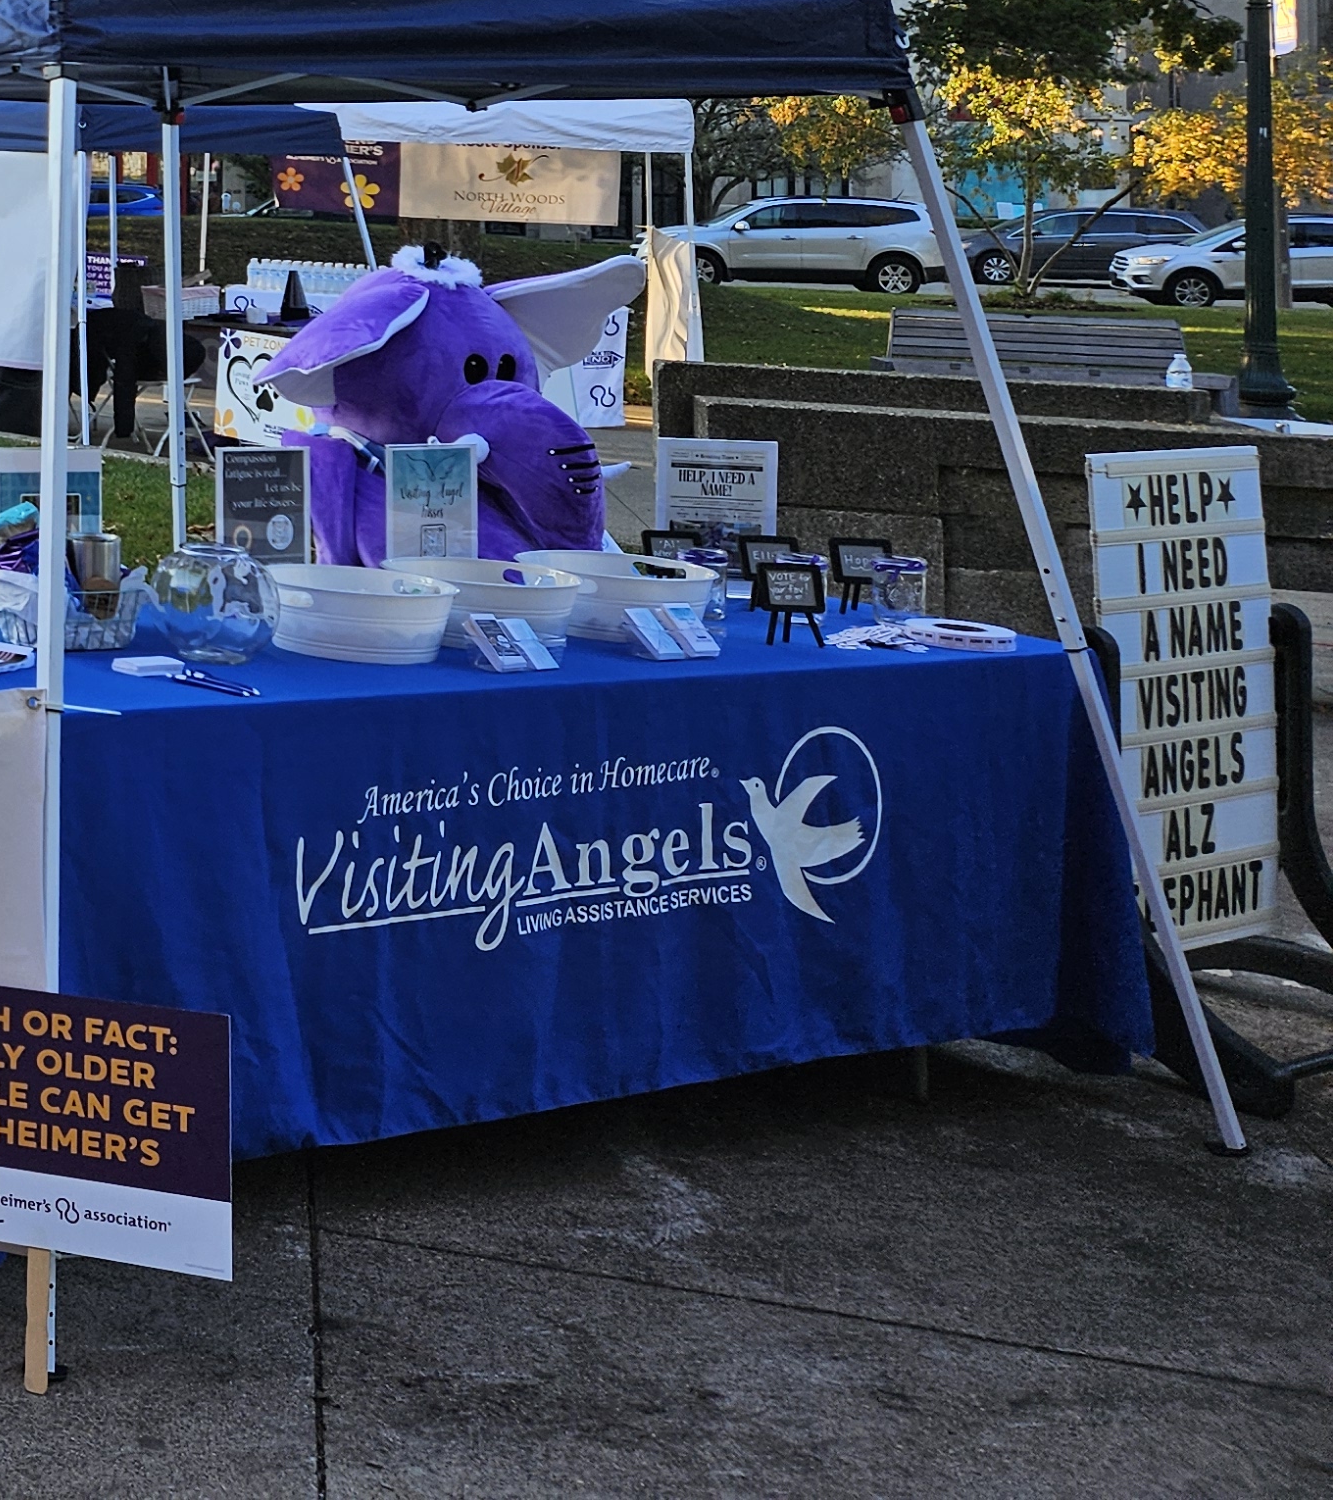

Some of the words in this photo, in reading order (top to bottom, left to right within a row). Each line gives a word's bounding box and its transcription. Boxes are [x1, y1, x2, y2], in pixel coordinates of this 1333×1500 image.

[454, 191, 506, 201] NORTH
[510, 192, 565, 204] WOODS
[481, 200, 537, 217] Village
[243, 336, 260, 347] PET
[225, 454, 276, 466] Compassion
[225, 469, 254, 481] fatigue
[679, 470, 709, 484] HELP,
[712, 471, 715, 482] I
[719, 472, 745, 485] NEED
[748, 473, 755, 485] A
[233, 501, 252, 511] your
[254, 498, 267, 507] life
[265, 483, 278, 492] Let
[292, 482, 301, 491] be
[701, 482, 732, 496] NAME!
[1148, 472, 1213, 526] HELP
[769, 573, 795, 581] VOTE
[1138, 543, 1146, 594] I
[1162, 537, 1228, 593] NEED
[1144, 610, 1160, 662] A
[1170, 600, 1244, 658] NAME
[1138, 665, 1247, 730] VISITING
[1144, 732, 1245, 798] ANGELS
[356, 771, 480, 824] America's
[486, 770, 563, 808] Choice
[569, 763, 595, 795] in
[1165, 803, 1216, 862] ALZ
[295, 820, 526, 951] Visiting
[516, 911, 563, 936] LIVING
[563, 896, 670, 926] ASSISTANCE
[670, 883, 753, 911] SERVICES
[23, 1011, 72, 1041] OR
[85, 1017, 178, 1056] FACT:
[36, 1049, 156, 1089] OLDER
[40, 1087, 111, 1121] CAN
[123, 1099, 195, 1133] GET
[84, 1207, 168, 1233] association
